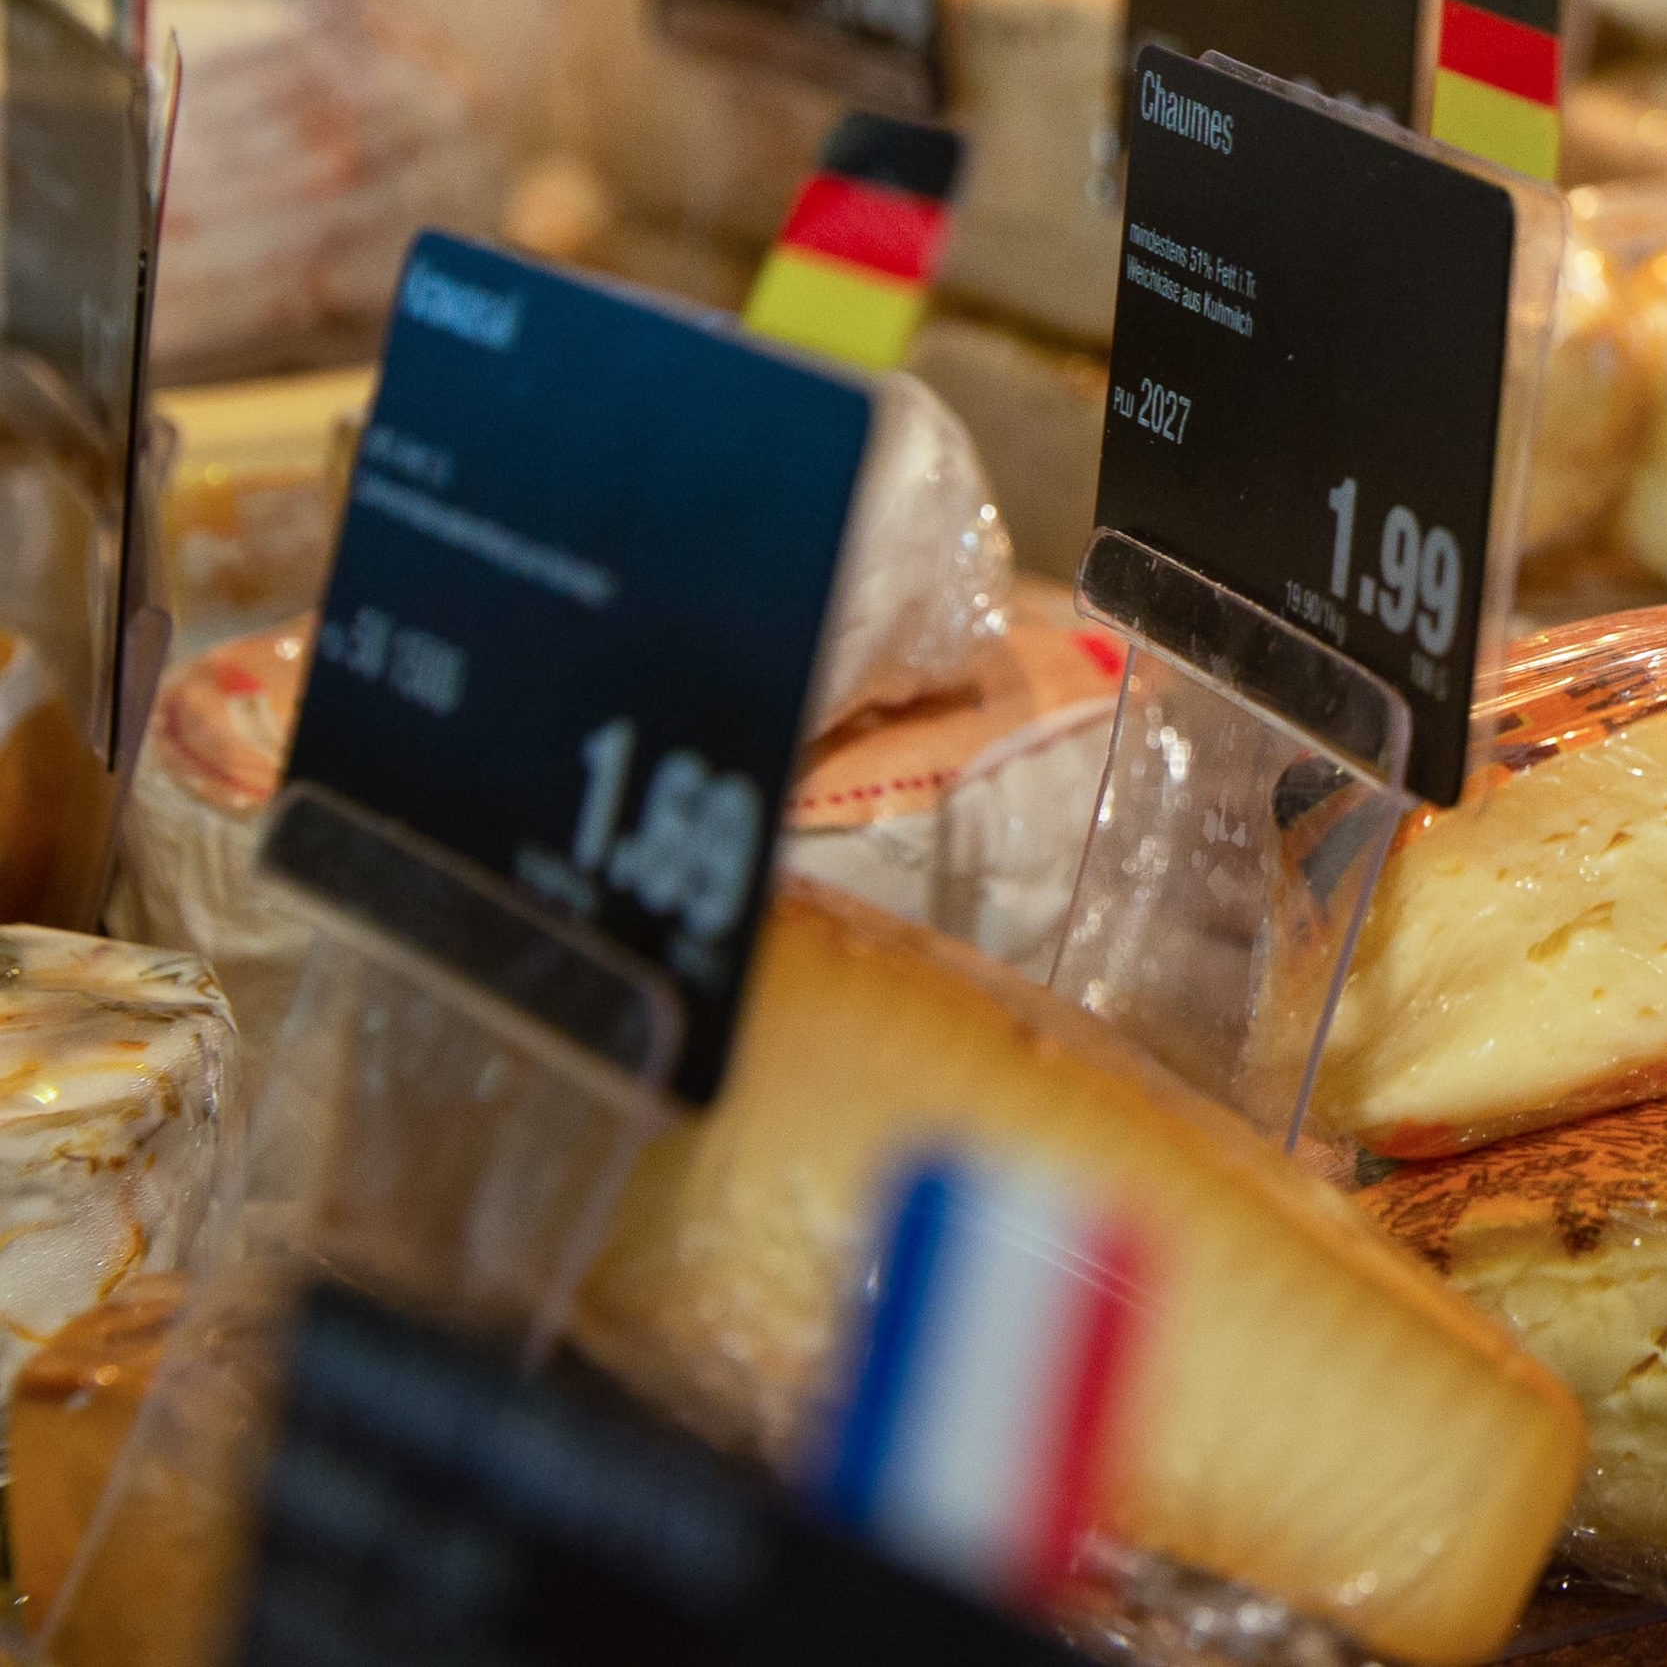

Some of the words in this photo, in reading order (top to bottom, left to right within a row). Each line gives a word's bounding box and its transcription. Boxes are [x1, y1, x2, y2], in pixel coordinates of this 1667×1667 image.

[1141, 70, 1234, 154] Chaumes
[1129, 222, 1188, 267] mindestens
[1126, 253, 1181, 304] Weichkäse
[1182, 285, 1201, 313] aus
[1203, 290, 1253, 337] Kuhmilch
[1113, 386, 1135, 419] PLU
[1137, 378, 1193, 445] 2027
[1329, 477, 1461, 657] 1.99
